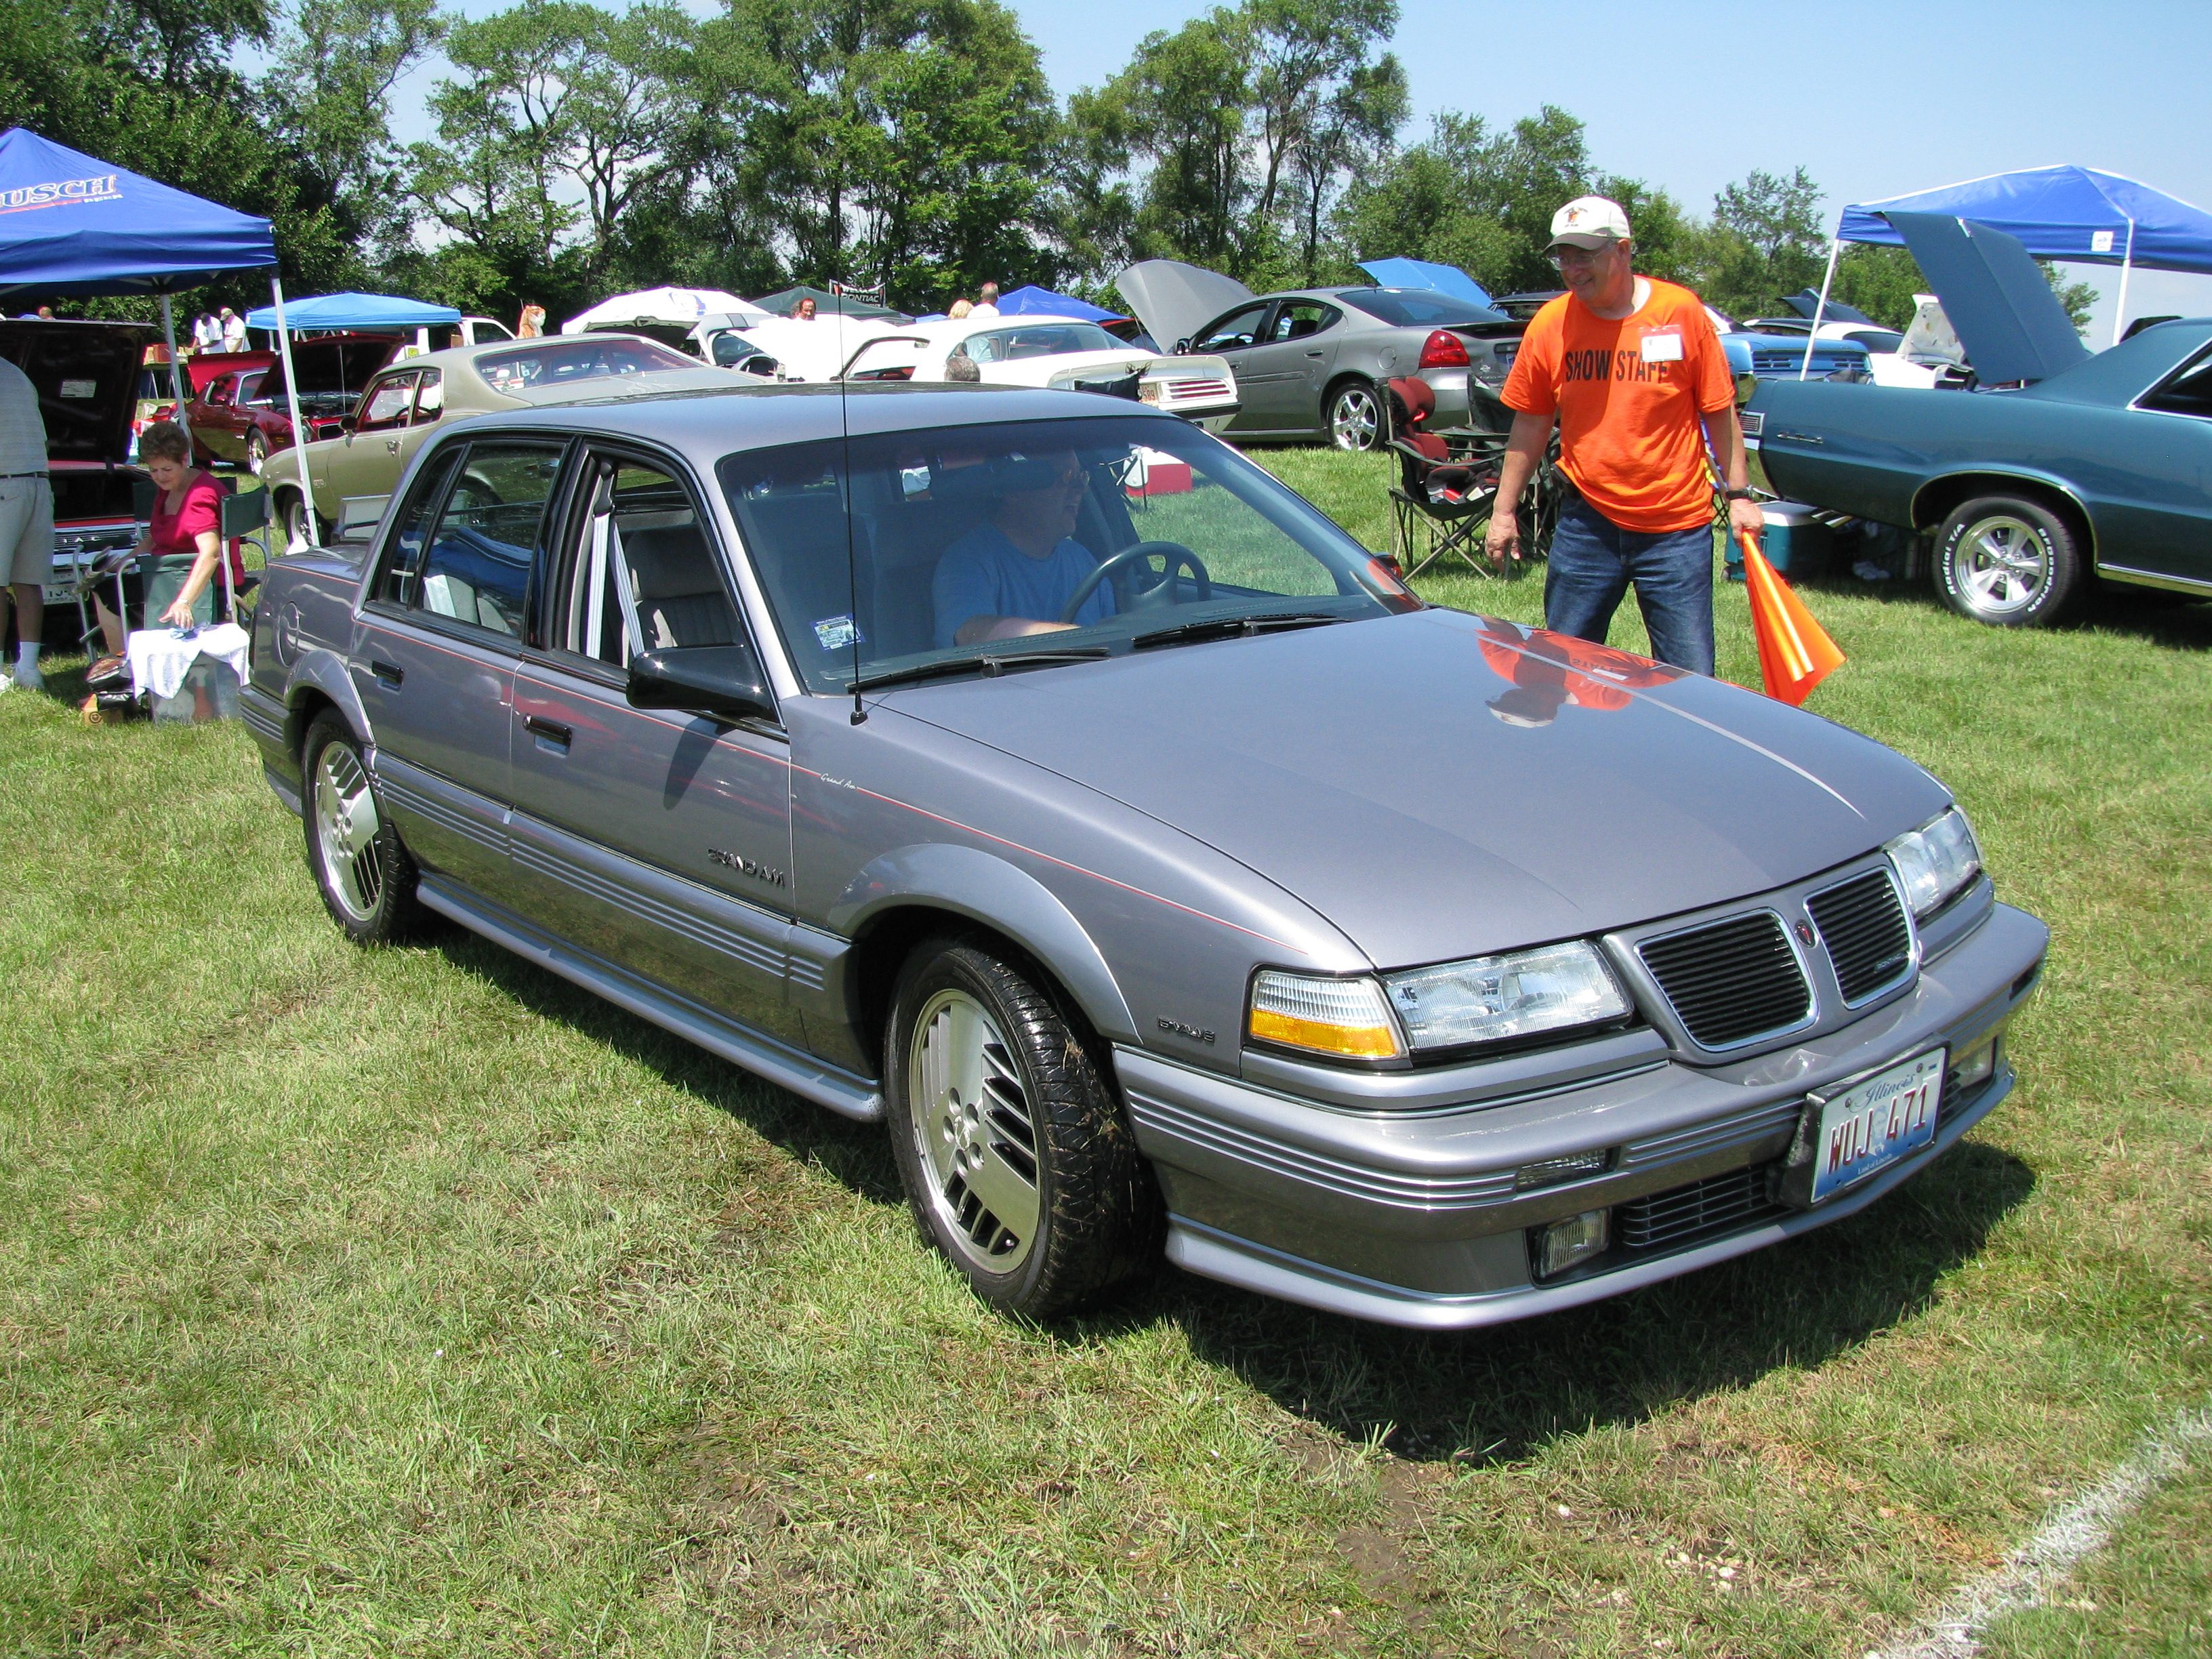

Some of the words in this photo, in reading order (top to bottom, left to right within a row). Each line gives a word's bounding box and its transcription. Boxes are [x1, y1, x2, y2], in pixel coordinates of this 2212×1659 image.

[0, 173, 117, 207] USCH
[1565, 350, 1611, 382] SHOW
[1948, 523, 1965, 542] T/A
[706, 847, 757, 876] GRAND
[760, 865, 785, 888] AM
[1849, 1073, 1916, 1113] Illinois
[1827, 1107, 1875, 1175] WUJ
[1885, 1082, 1928, 1141] 471
